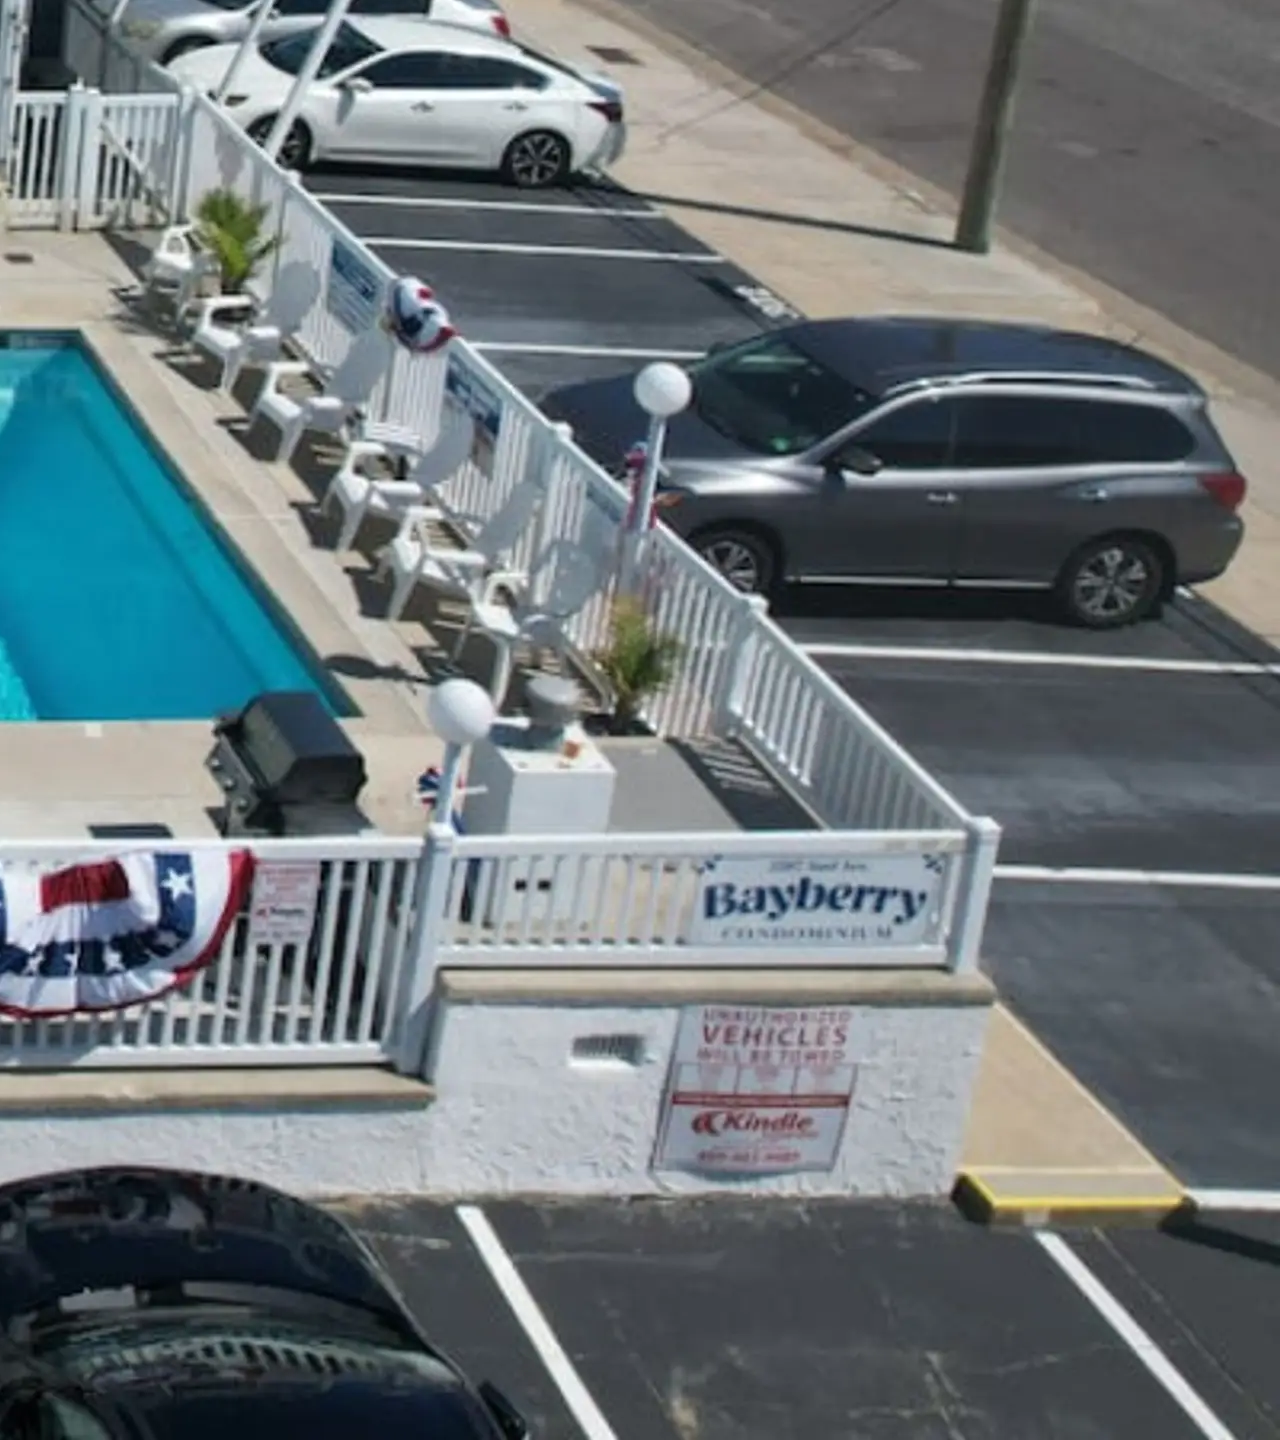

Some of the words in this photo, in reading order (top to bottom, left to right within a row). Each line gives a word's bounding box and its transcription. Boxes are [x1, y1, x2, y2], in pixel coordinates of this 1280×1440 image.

[703, 877, 928, 924] Bayberry
[702, 1024, 848, 1047] VEHICLES
[722, 1111, 814, 1132] Kindle
